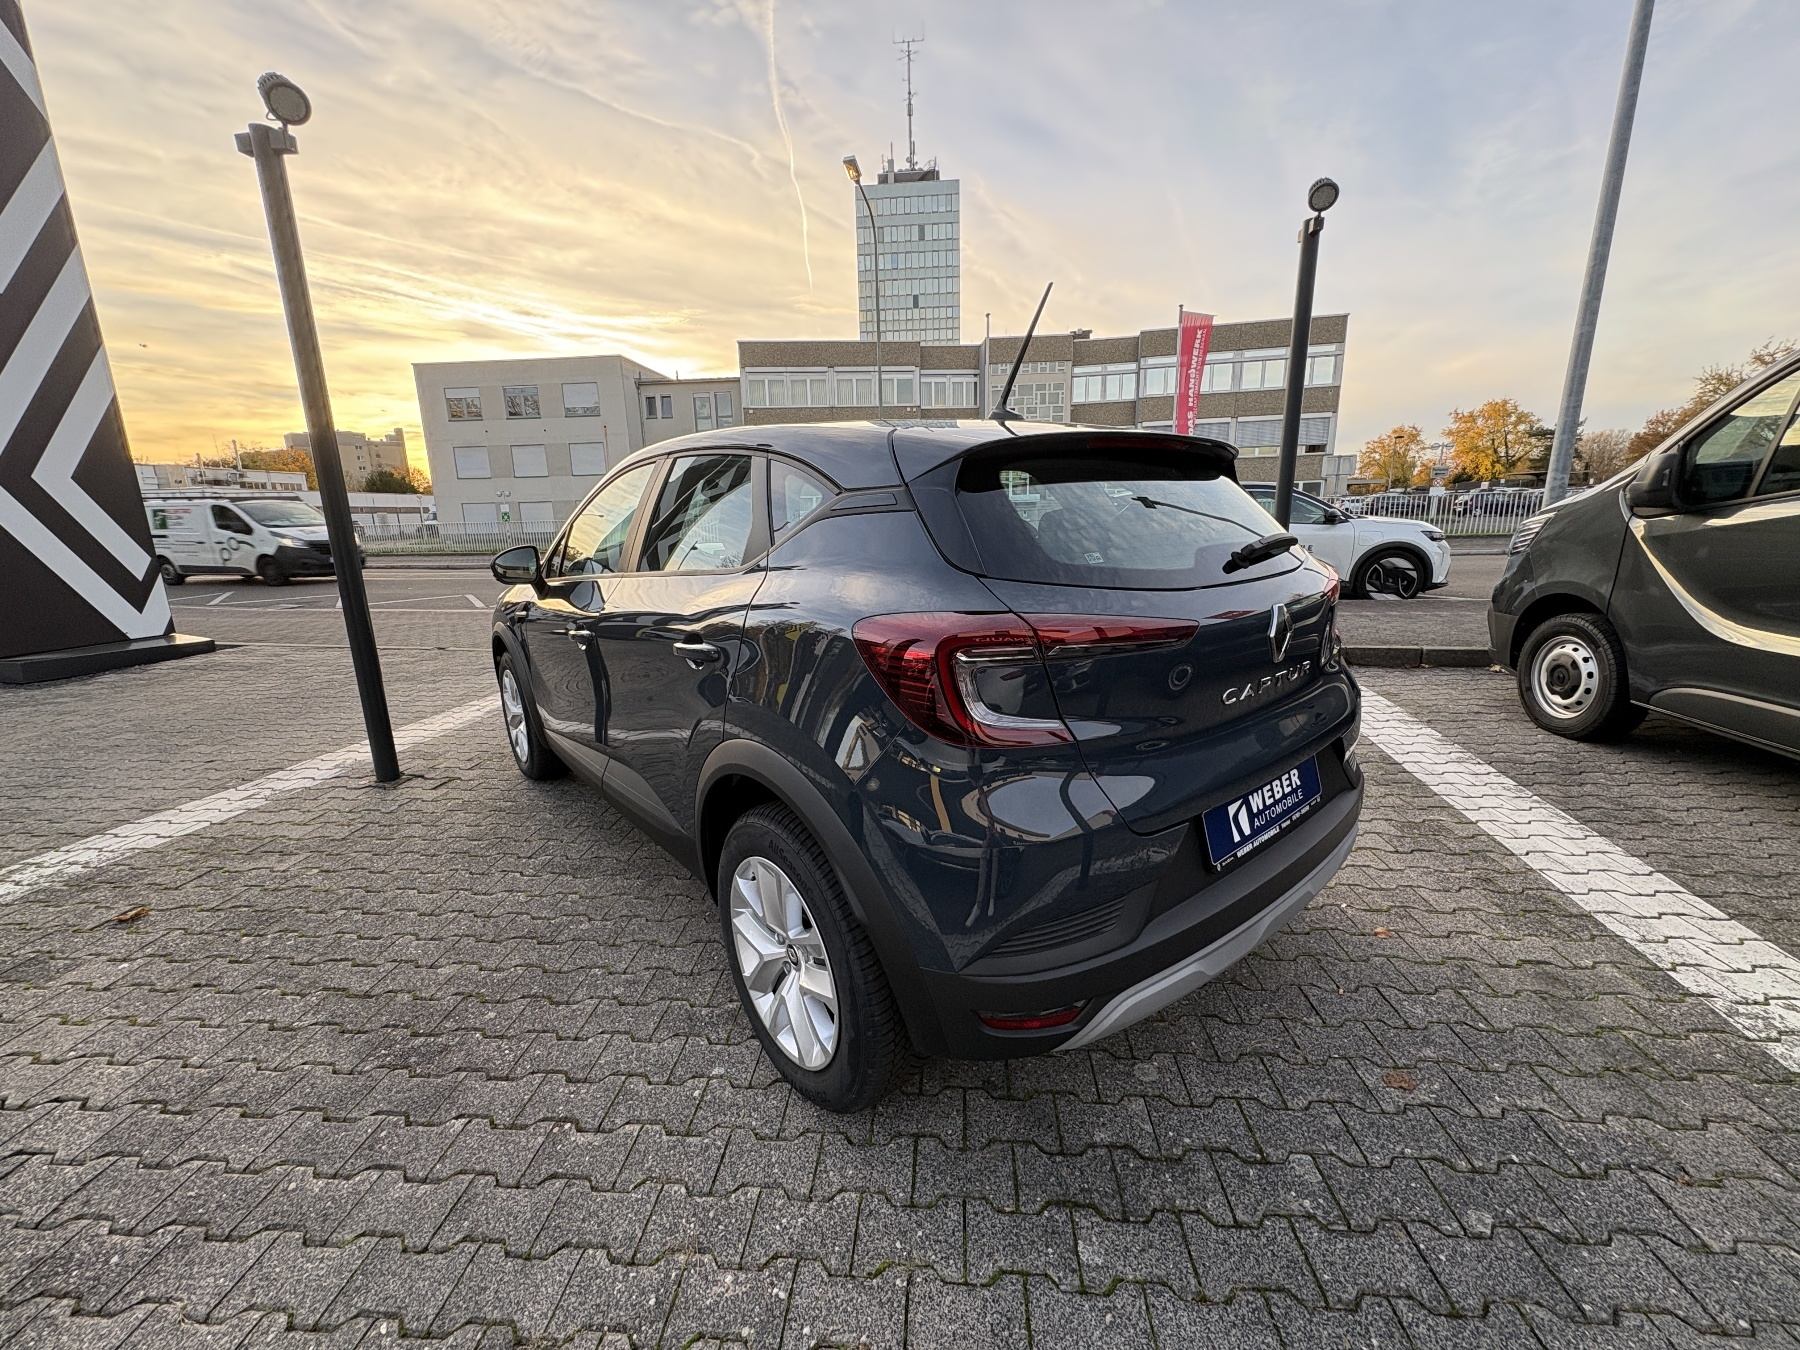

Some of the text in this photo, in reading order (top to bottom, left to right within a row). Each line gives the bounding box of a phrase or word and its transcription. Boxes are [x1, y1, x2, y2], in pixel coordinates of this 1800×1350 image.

[1222, 660, 1311, 705] CAPTUR
[1248, 768, 1301, 814] WEBER
[1254, 789, 1304, 829] AUTOMOBILE
